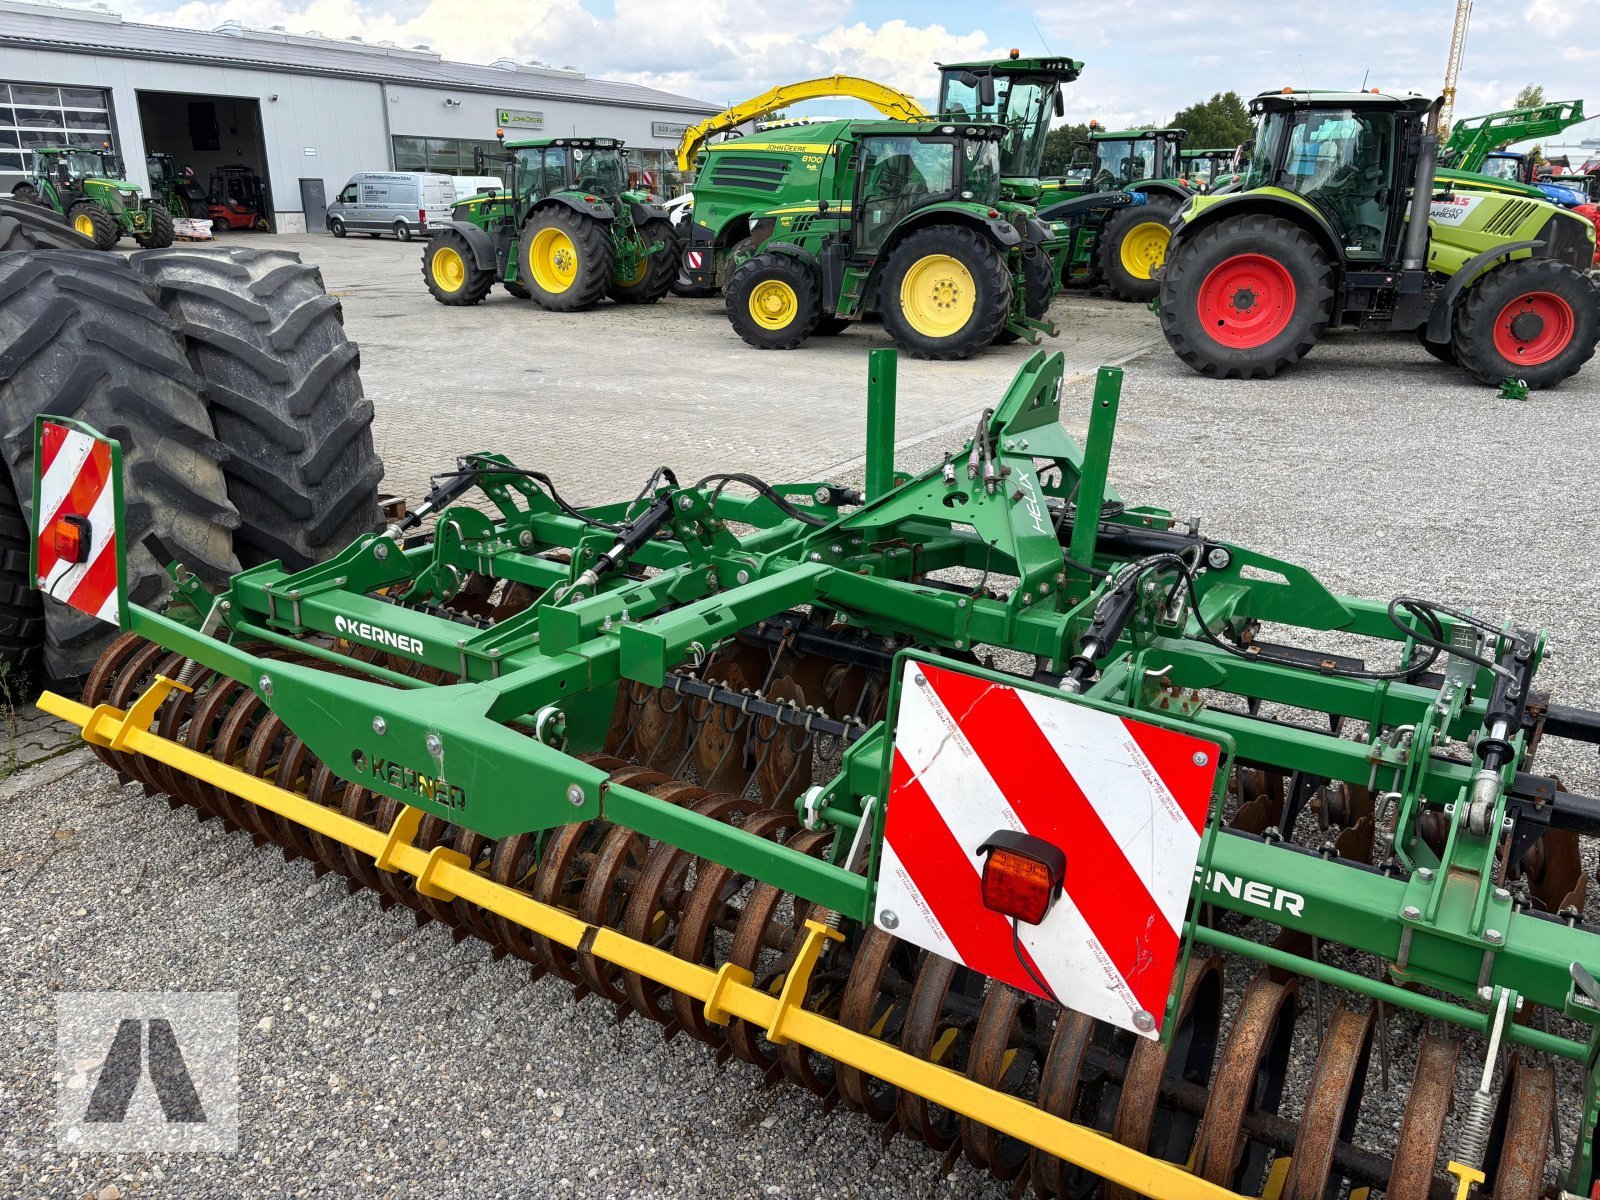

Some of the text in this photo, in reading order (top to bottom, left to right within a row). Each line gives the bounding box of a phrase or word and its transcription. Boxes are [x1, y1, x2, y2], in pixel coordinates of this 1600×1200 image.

[785, 144, 807, 152] DEERE
[801, 155, 823, 164] 8100
[1429, 211, 1459, 219] ARION
[346, 619, 424, 656] KERNER
[371, 754, 466, 812] KERNER
